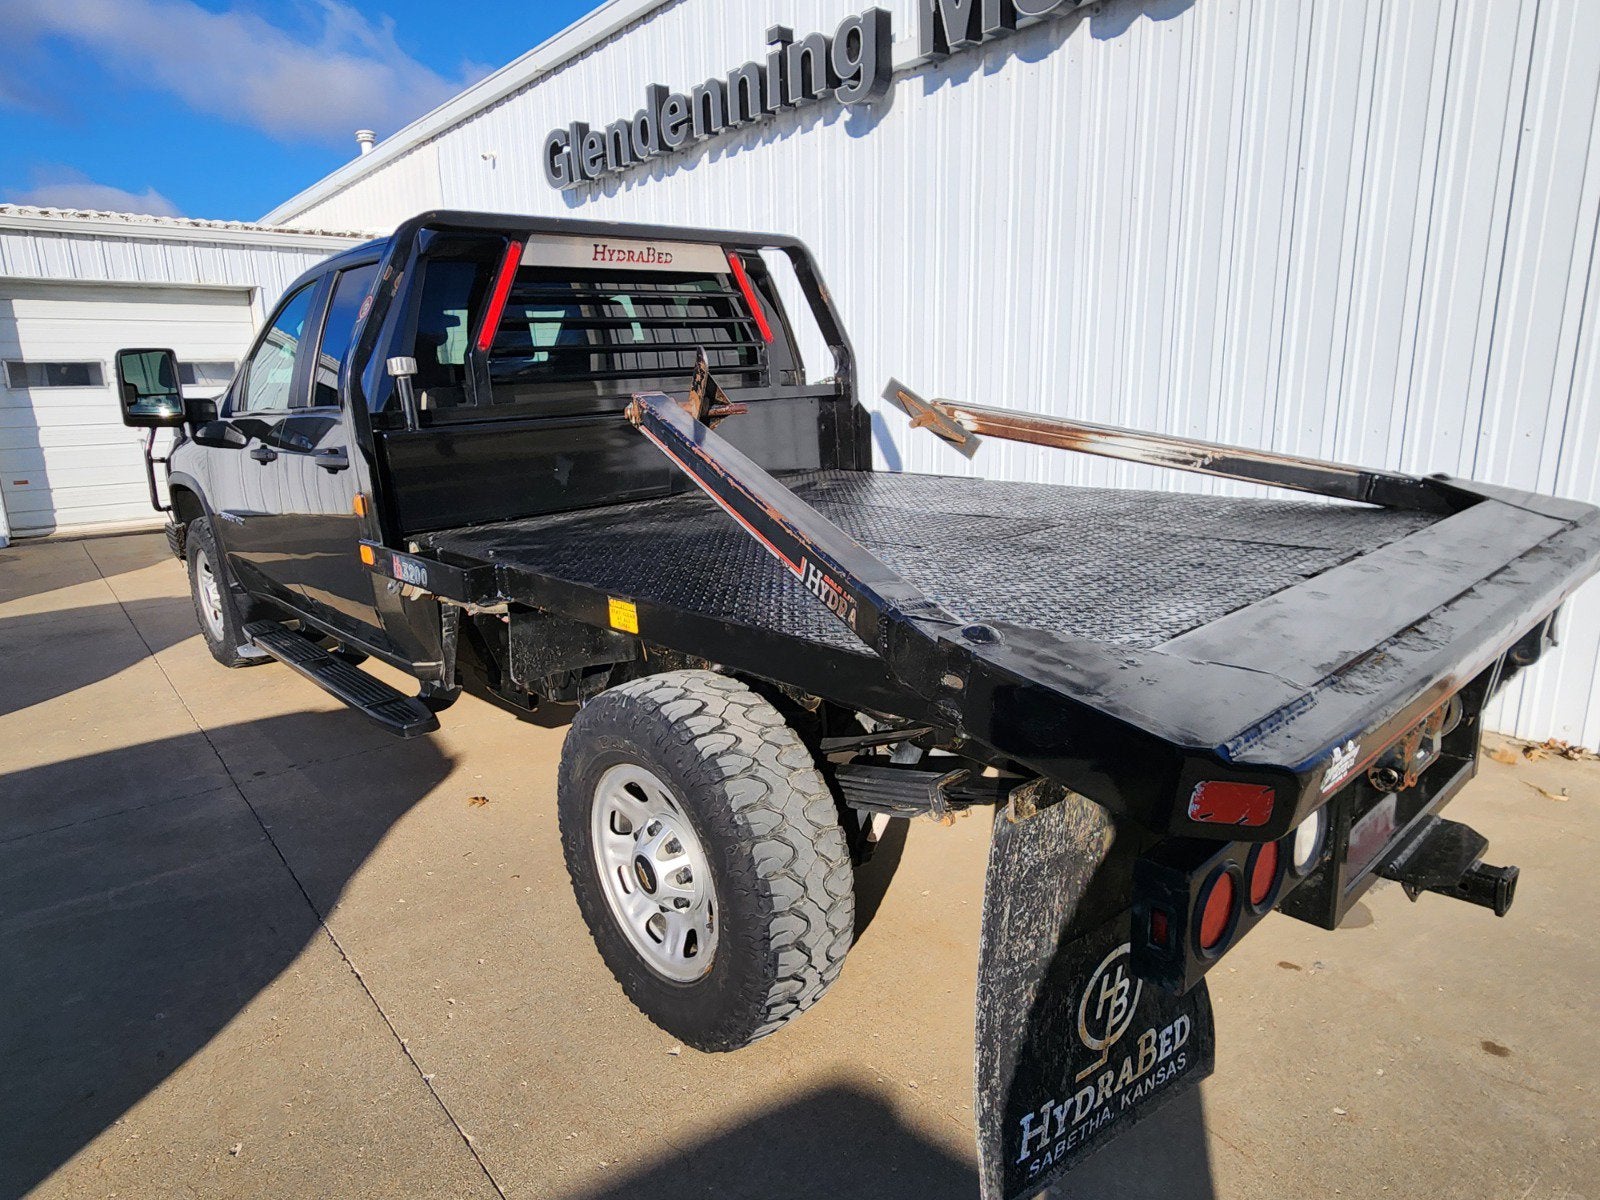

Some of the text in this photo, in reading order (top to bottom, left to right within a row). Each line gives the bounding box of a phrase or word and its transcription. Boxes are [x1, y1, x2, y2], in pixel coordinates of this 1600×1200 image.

[543, 7, 888, 191] Glendenning
[402, 561, 427, 588] 3200
[805, 562, 857, 631] HYDRA
[1028, 1052, 1187, 1178] SABETHA, KANSAS
